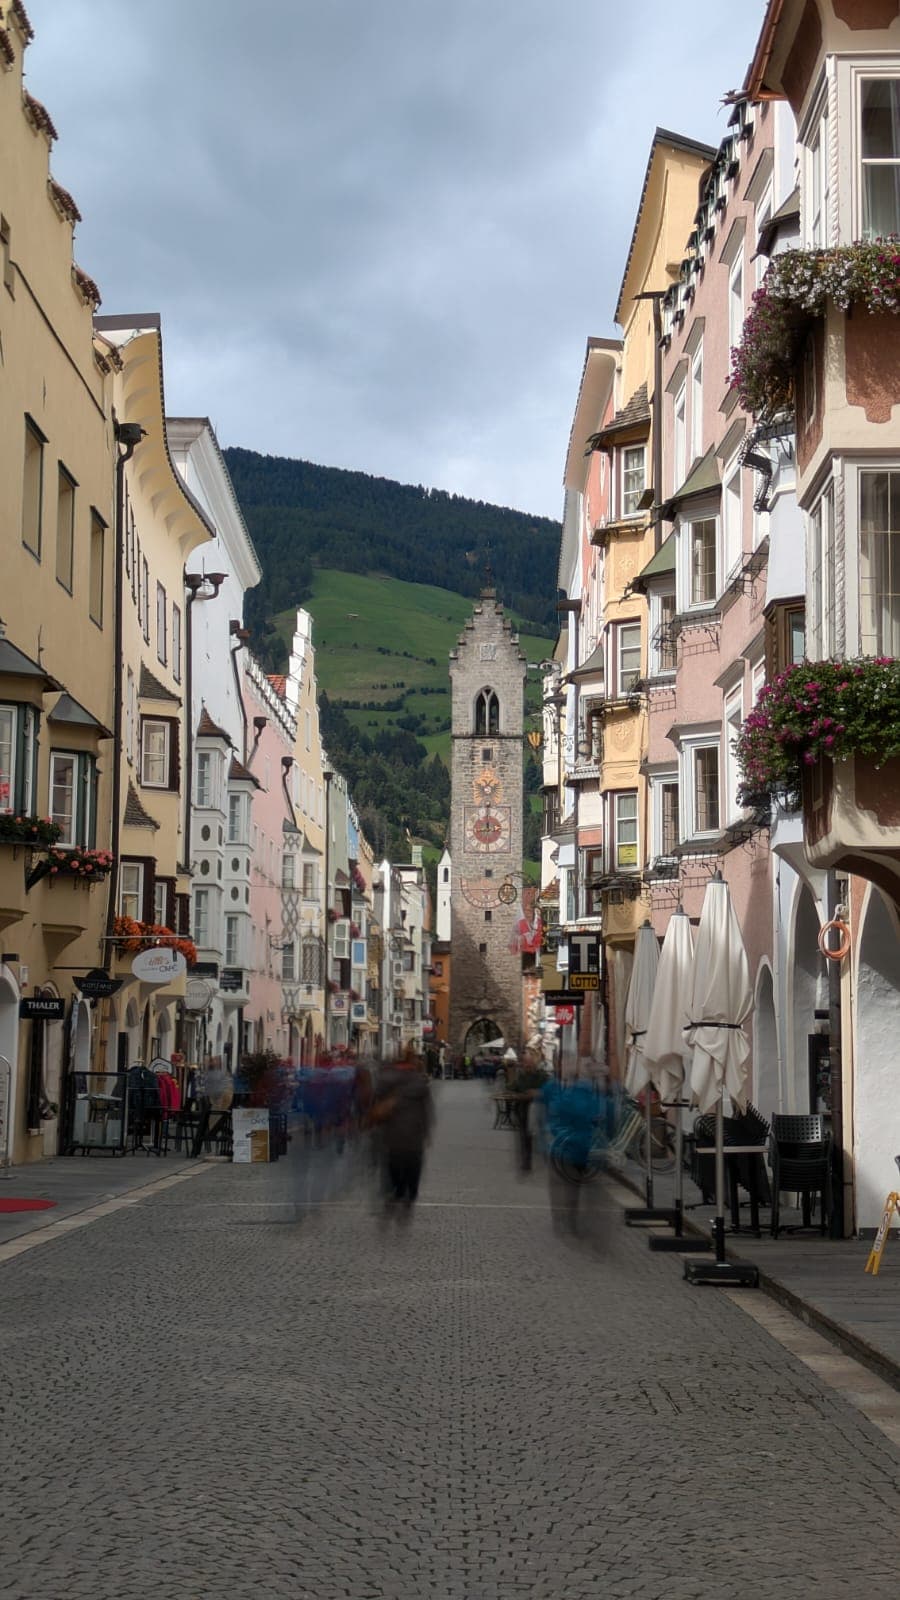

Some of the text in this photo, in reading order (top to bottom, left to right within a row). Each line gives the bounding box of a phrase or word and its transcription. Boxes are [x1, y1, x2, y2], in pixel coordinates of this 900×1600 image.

[572, 936, 597, 972] T
[572, 977, 597, 987] LOTTO
[27, 1001, 60, 1010] THALER
[556, 1008, 573, 1022] illy
